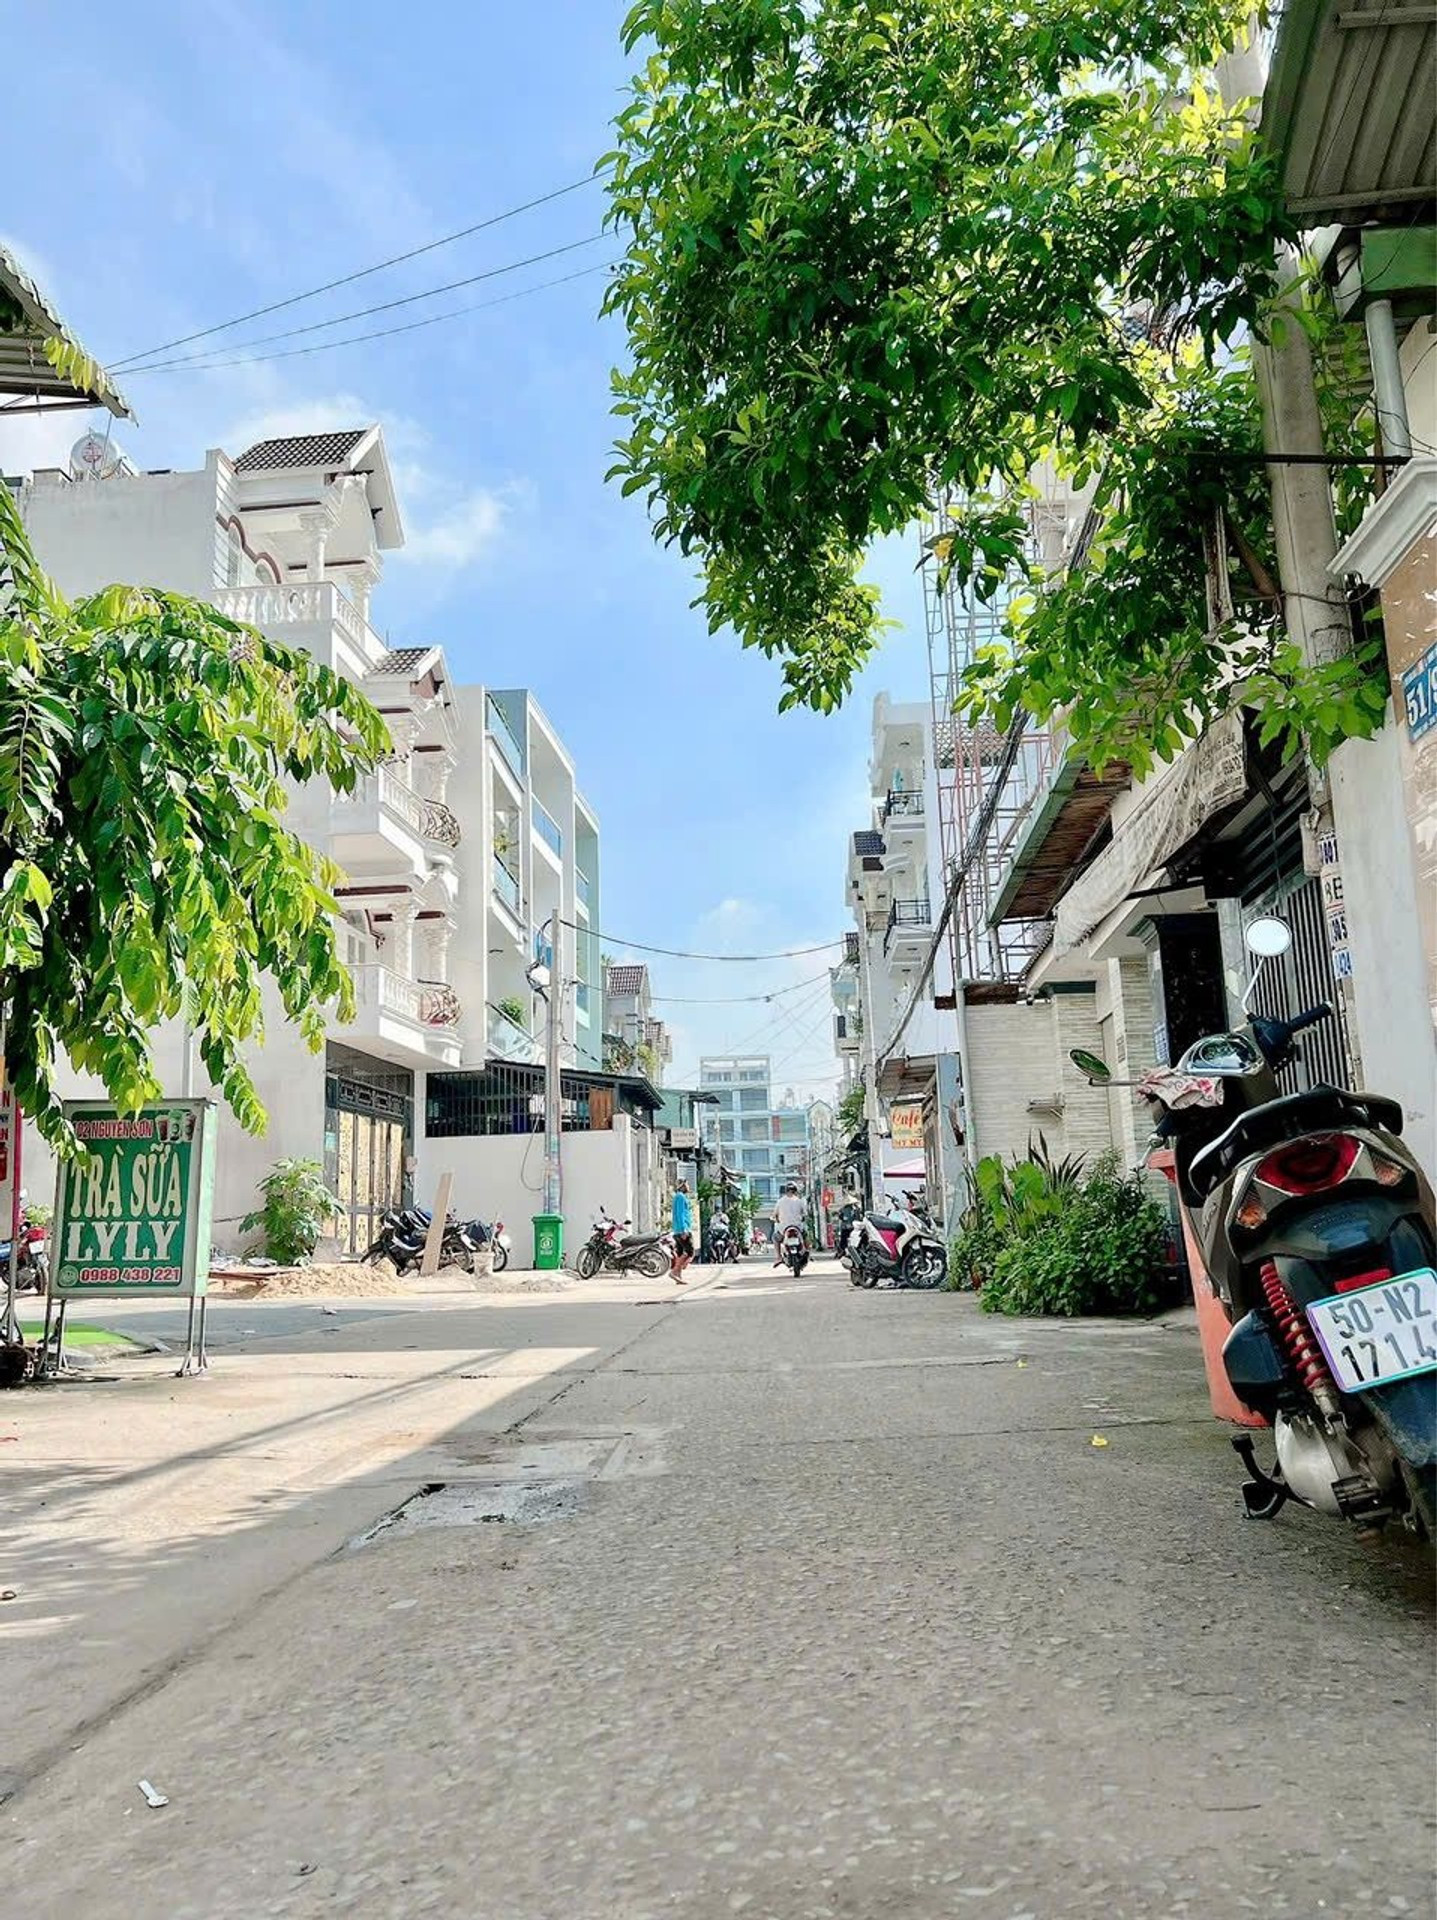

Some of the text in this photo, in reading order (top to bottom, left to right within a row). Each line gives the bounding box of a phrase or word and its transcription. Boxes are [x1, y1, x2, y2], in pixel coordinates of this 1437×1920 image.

[70, 1143, 183, 1217] TRÀ SỮA
[64, 1221, 181, 1261] LYLY
[79, 1267, 181, 1283] 0988 438 221
[1327, 1281, 1432, 1339] 50-N2
[1341, 1321, 1437, 1382] 171.4
